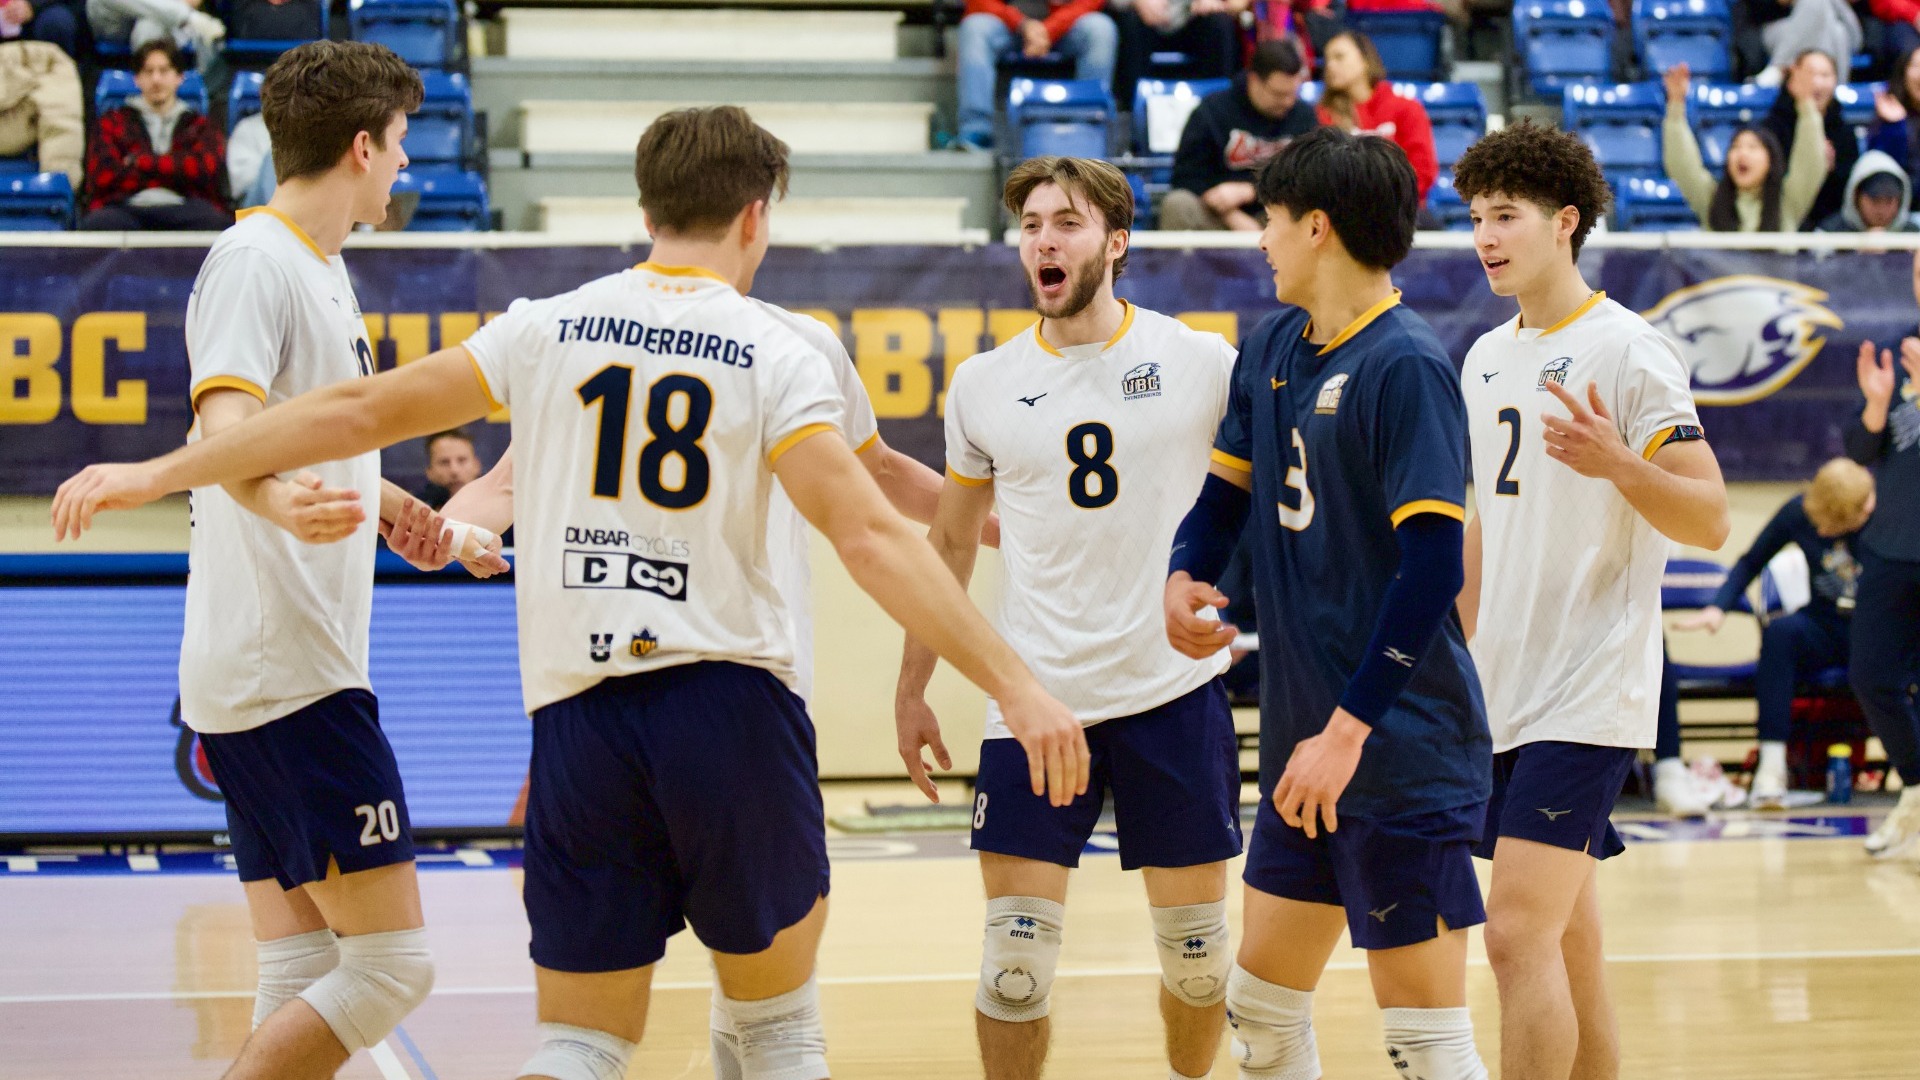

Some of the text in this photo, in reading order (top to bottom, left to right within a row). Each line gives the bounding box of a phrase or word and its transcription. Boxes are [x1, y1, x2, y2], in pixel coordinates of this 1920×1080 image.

[558, 316, 755, 369] THUNDERBIRDS
[1121, 375, 1161, 395] UBC
[574, 361, 715, 512] 18
[1495, 406, 1521, 497] 2
[1063, 420, 1120, 511] 8
[1277, 427, 1315, 531] 3
[565, 527, 690, 558] DUNBAR CYCLES
[354, 800, 400, 846] 20
[973, 792, 988, 830] 8
[1010, 929, 1035, 940] errea
[1183, 951, 1207, 959] errea
